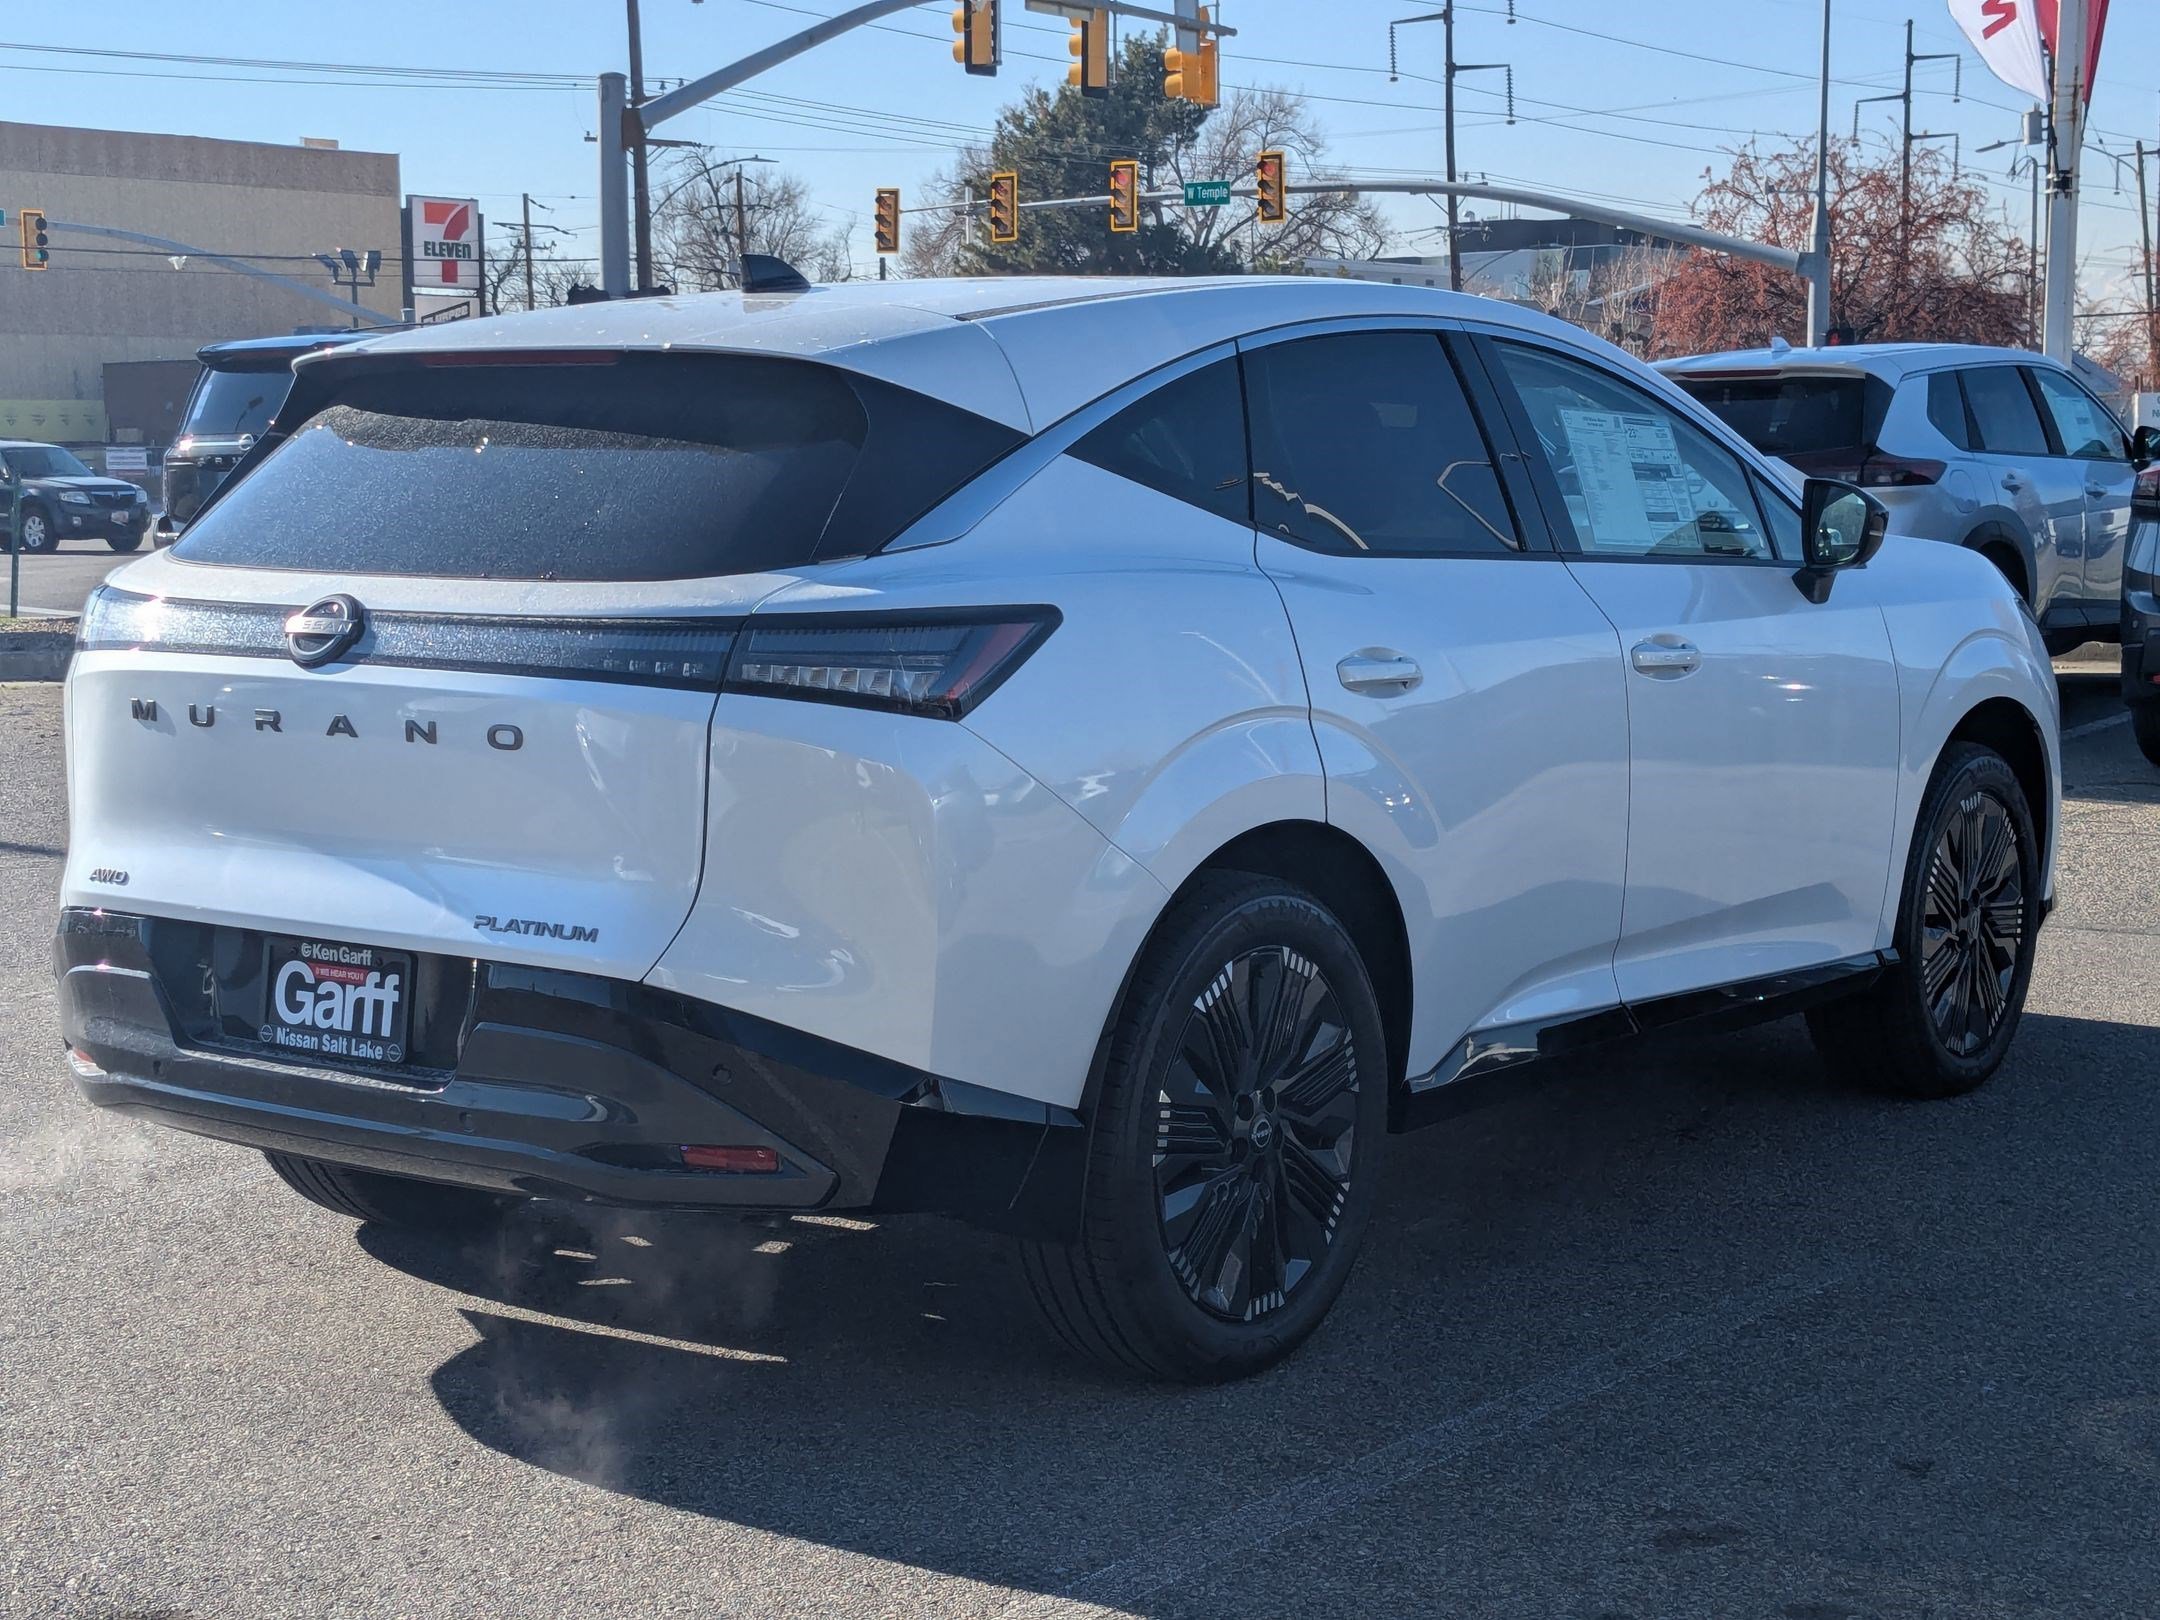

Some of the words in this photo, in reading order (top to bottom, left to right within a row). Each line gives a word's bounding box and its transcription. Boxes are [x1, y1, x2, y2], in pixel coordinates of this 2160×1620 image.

[1186, 186, 1196, 200] W
[1196, 185, 1229, 201] Temple
[423, 201, 470, 284] 7
[130, 697, 524, 752] MURANO
[89, 868, 130, 886] AWD
[473, 914, 600, 943] PLATINUM
[312, 943, 338, 962] Ken
[338, 946, 373, 966] Garff
[274, 959, 400, 1038] Garff
[276, 1027, 318, 1050] Nissan
[321, 1034, 348, 1054] Salt
[351, 1039, 384, 1060] Lake
